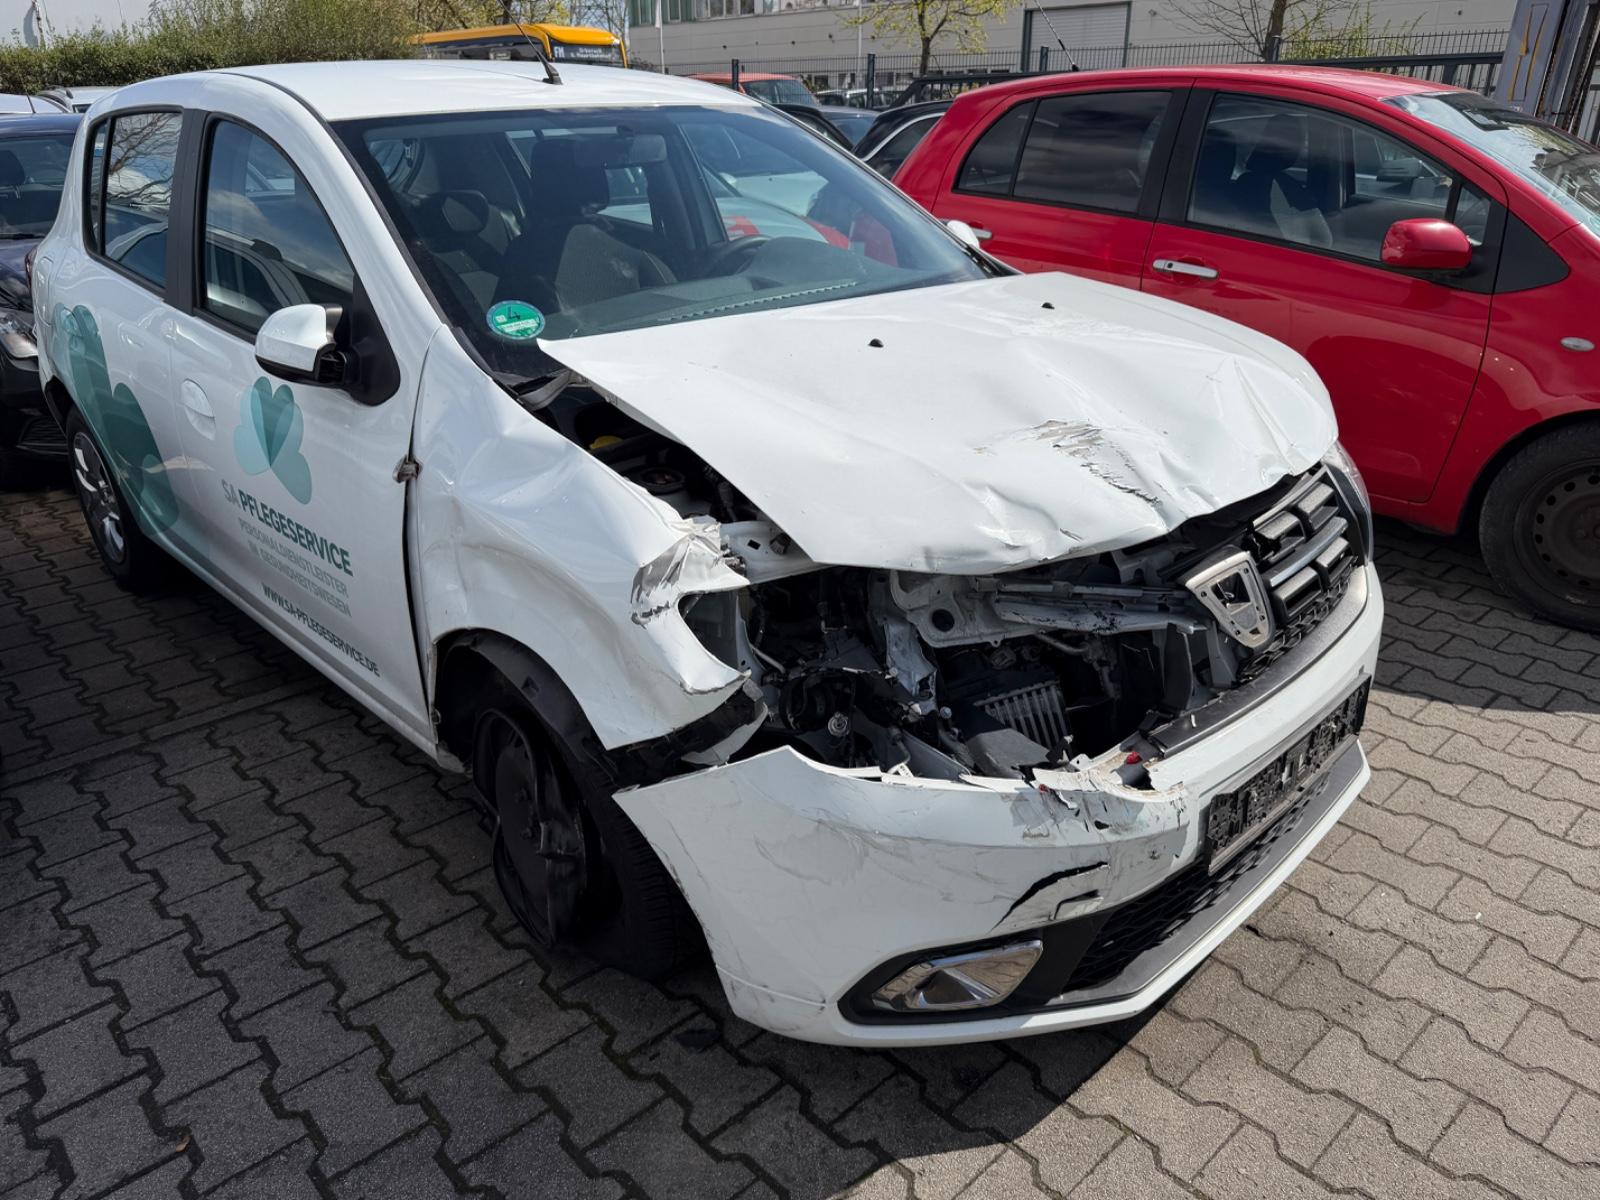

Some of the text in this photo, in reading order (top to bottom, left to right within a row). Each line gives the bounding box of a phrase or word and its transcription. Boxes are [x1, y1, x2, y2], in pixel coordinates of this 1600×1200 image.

[221, 479, 353, 577] SA PFLEGESERVICE
[238, 517, 349, 599] PERSONALDIENSTLEISTER
[261, 583, 381, 677] WWW.SA-PFLEGESERVICE.DE
